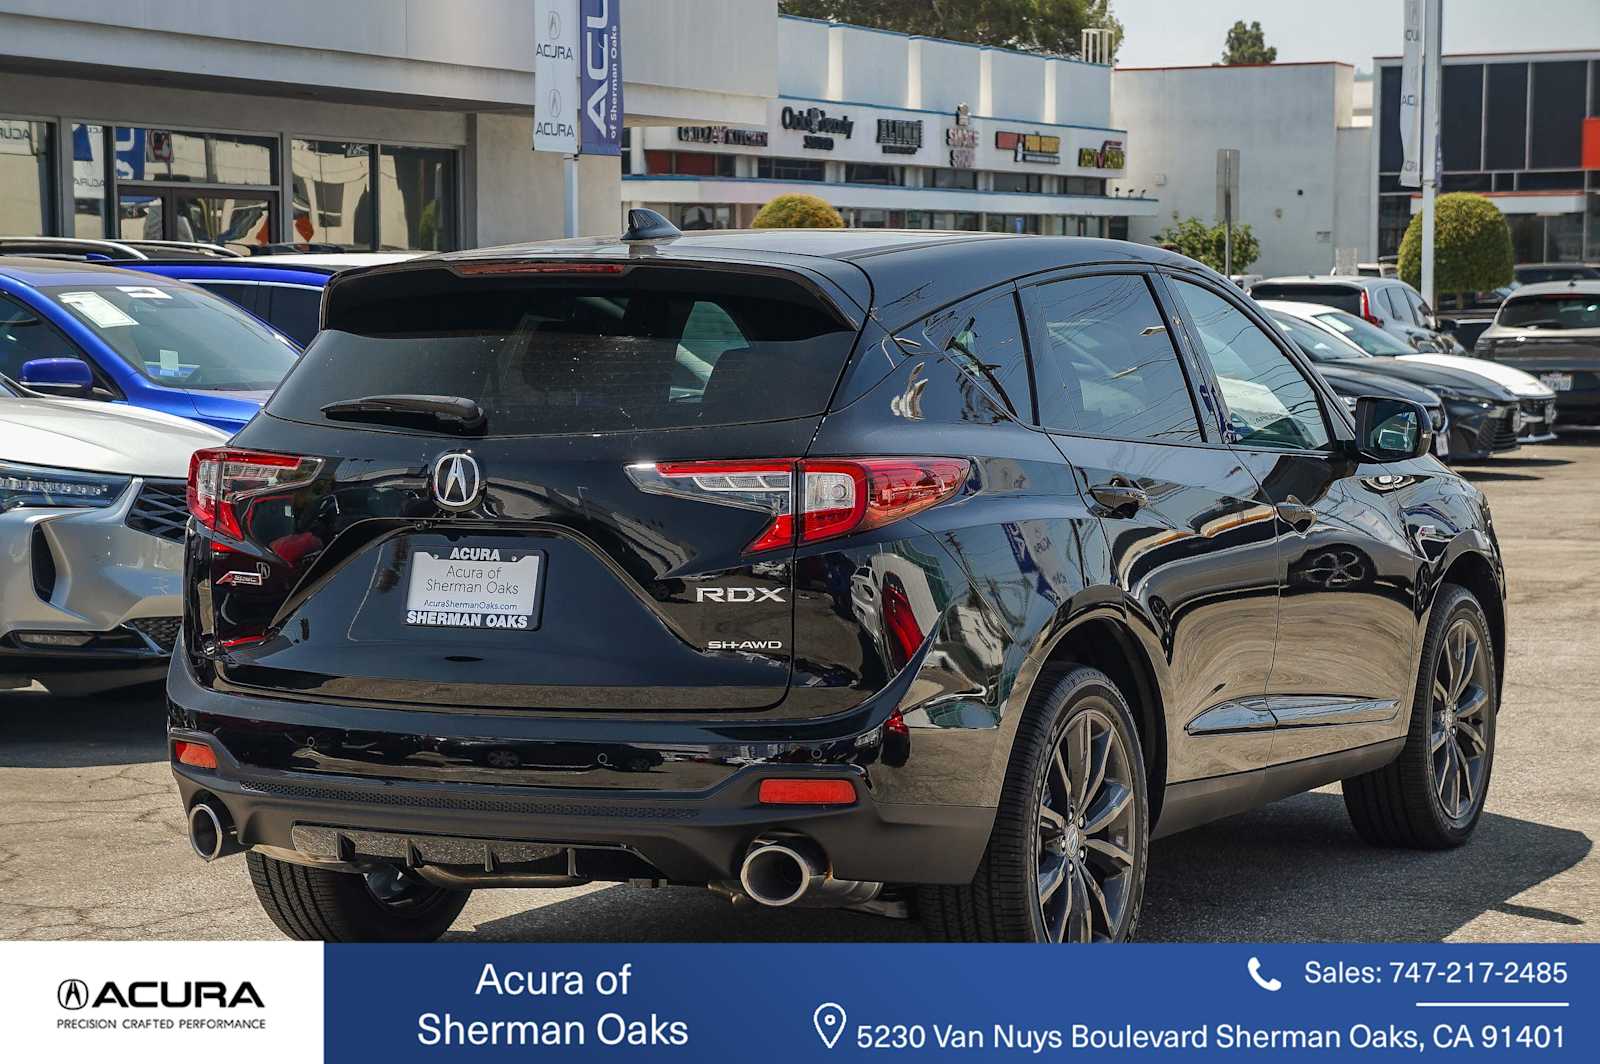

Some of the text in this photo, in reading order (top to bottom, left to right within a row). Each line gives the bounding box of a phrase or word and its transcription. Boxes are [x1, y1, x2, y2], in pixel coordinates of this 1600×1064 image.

[536, 43, 573, 60] ACURA
[587, 0, 608, 138] ACU
[536, 122, 574, 137] ACURA
[450, 547, 500, 561] ACURA
[446, 565, 502, 579] Acura of
[425, 578, 519, 595] Sherman Oaks
[696, 587, 786, 603] RDX
[423, 599, 518, 611] AcuraShermanOaks.com
[406, 610, 528, 628] SHERMAN OAKS
[708, 640, 783, 649] SH-AWD
